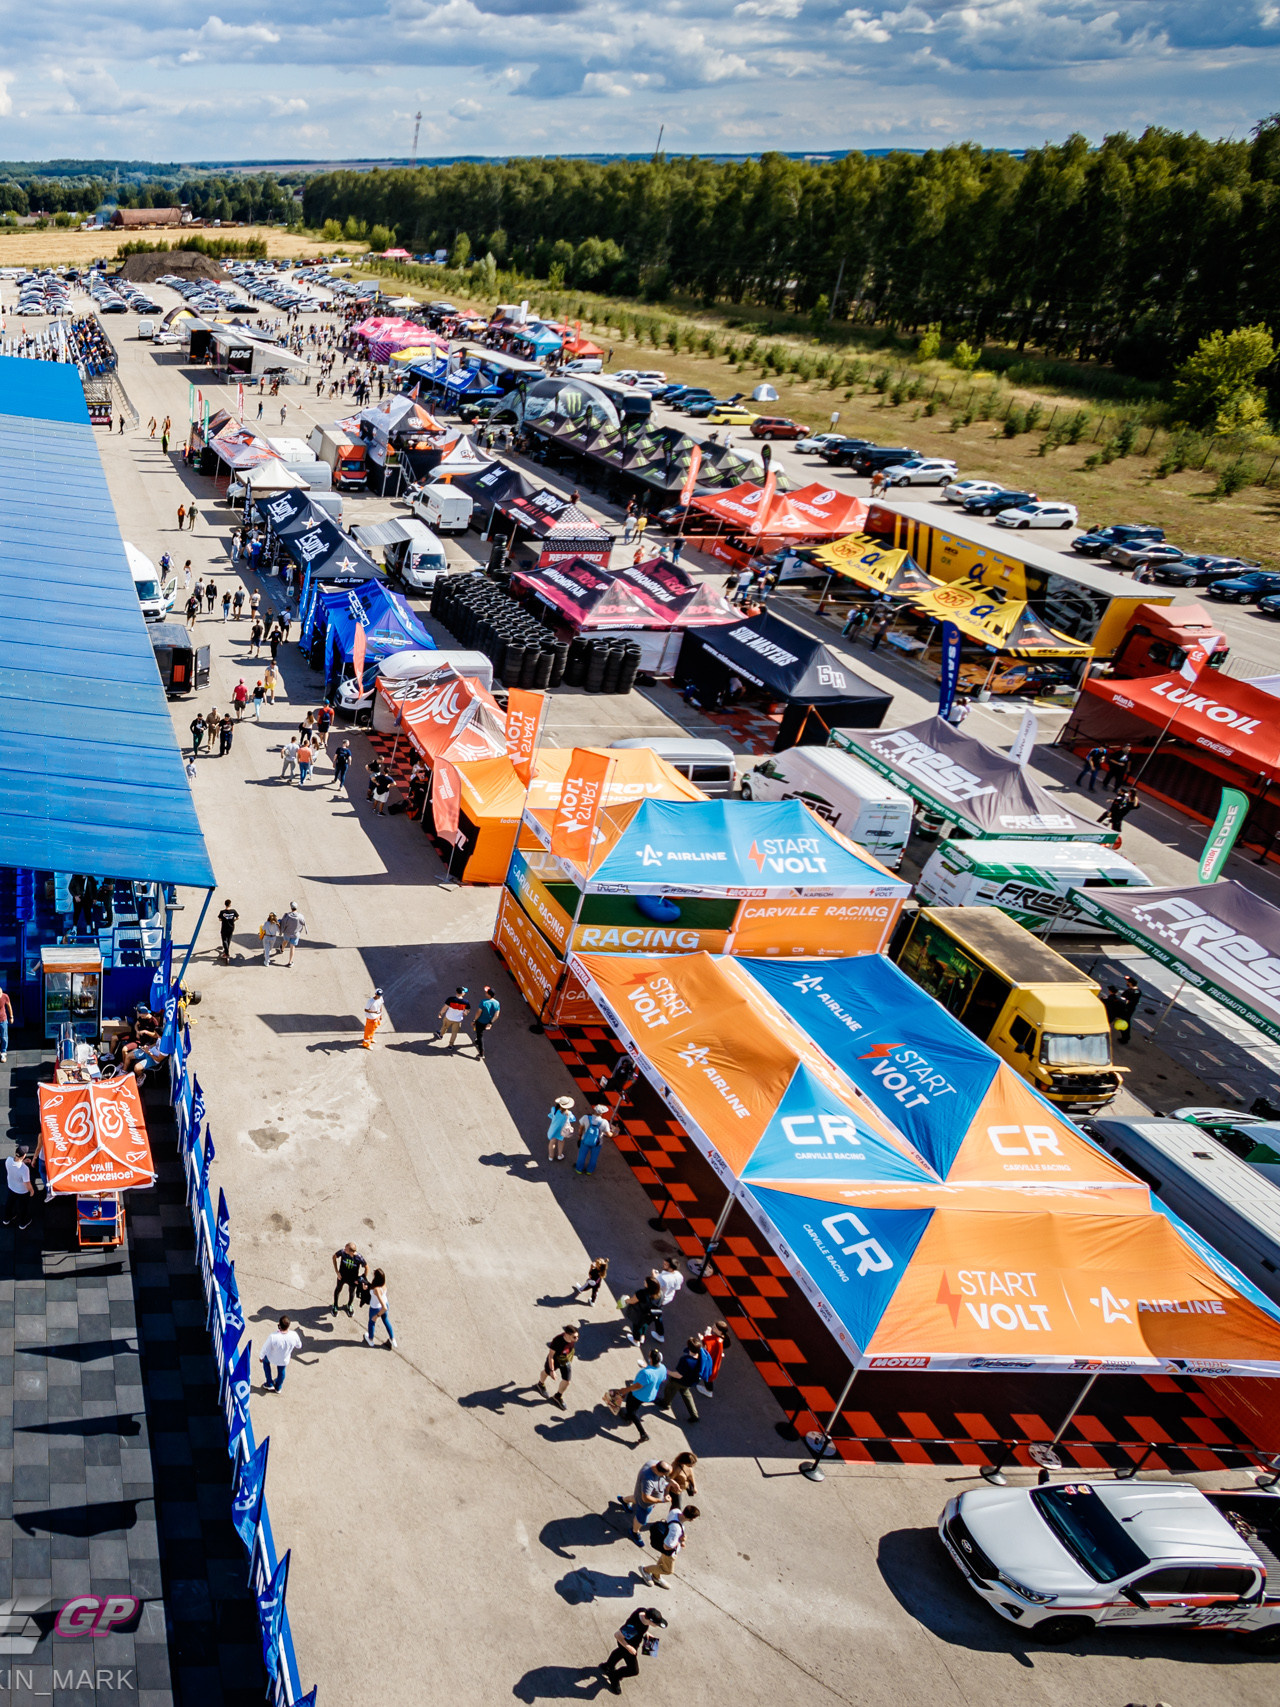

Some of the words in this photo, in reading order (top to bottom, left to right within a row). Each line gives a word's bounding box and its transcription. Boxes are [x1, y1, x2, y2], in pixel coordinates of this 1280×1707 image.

[230, 350, 250, 358] RDS
[749, 638, 799, 667] MASTERS
[1150, 681, 1262, 735] LUKOIL
[1196, 736, 1235, 757] GENESIS
[524, 779, 664, 795] FEROV
[666, 851, 727, 862] AIRLINE
[764, 838, 820, 855] START
[771, 857, 827, 874] VOLT
[512, 864, 539, 907] CARVILLE
[538, 901, 565, 938] RACING
[727, 889, 766, 898] MOTUL
[744, 906, 819, 918] CARVILLE
[824, 905, 889, 918] RACING
[581, 929, 701, 949] RACING
[1104, 915, 1137, 940] FRESHAUTO
[1135, 934, 1153, 950] DRIFT
[1152, 947, 1170, 962] TEAM
[1171, 961, 1207, 988] FRESH
[1207, 986, 1247, 1016] FRESHAUTO
[1245, 1010, 1266, 1029] DRIFT
[626, 985, 670, 1029] VOLT
[649, 976, 692, 1019] START
[817, 992, 863, 1032] AIRLINE
[871, 1058, 930, 1109] VOLT
[894, 1049, 957, 1098] START
[702, 1066, 751, 1120] AIRLINE
[780, 1114, 862, 1146] CR
[986, 1125, 1065, 1157] CR
[91, 1161, 114, 1173] УРА!!!
[795, 1152, 833, 1160] CARVILLE
[834, 1152, 866, 1161] RACING
[1002, 1163, 1040, 1172] CARVILLE
[1041, 1163, 1072, 1172] RACING
[802, 1223, 830, 1259] CARVILLE
[826, 1254, 850, 1283] RACING
[821, 1212, 894, 1277] CR
[957, 1270, 1039, 1297] START
[965, 1303, 1053, 1332] VOLT
[1137, 1298, 1227, 1315] AIRLINE
[869, 1357, 928, 1369] MOTUL
[1185, 1366, 1232, 1375] КАРБОН
